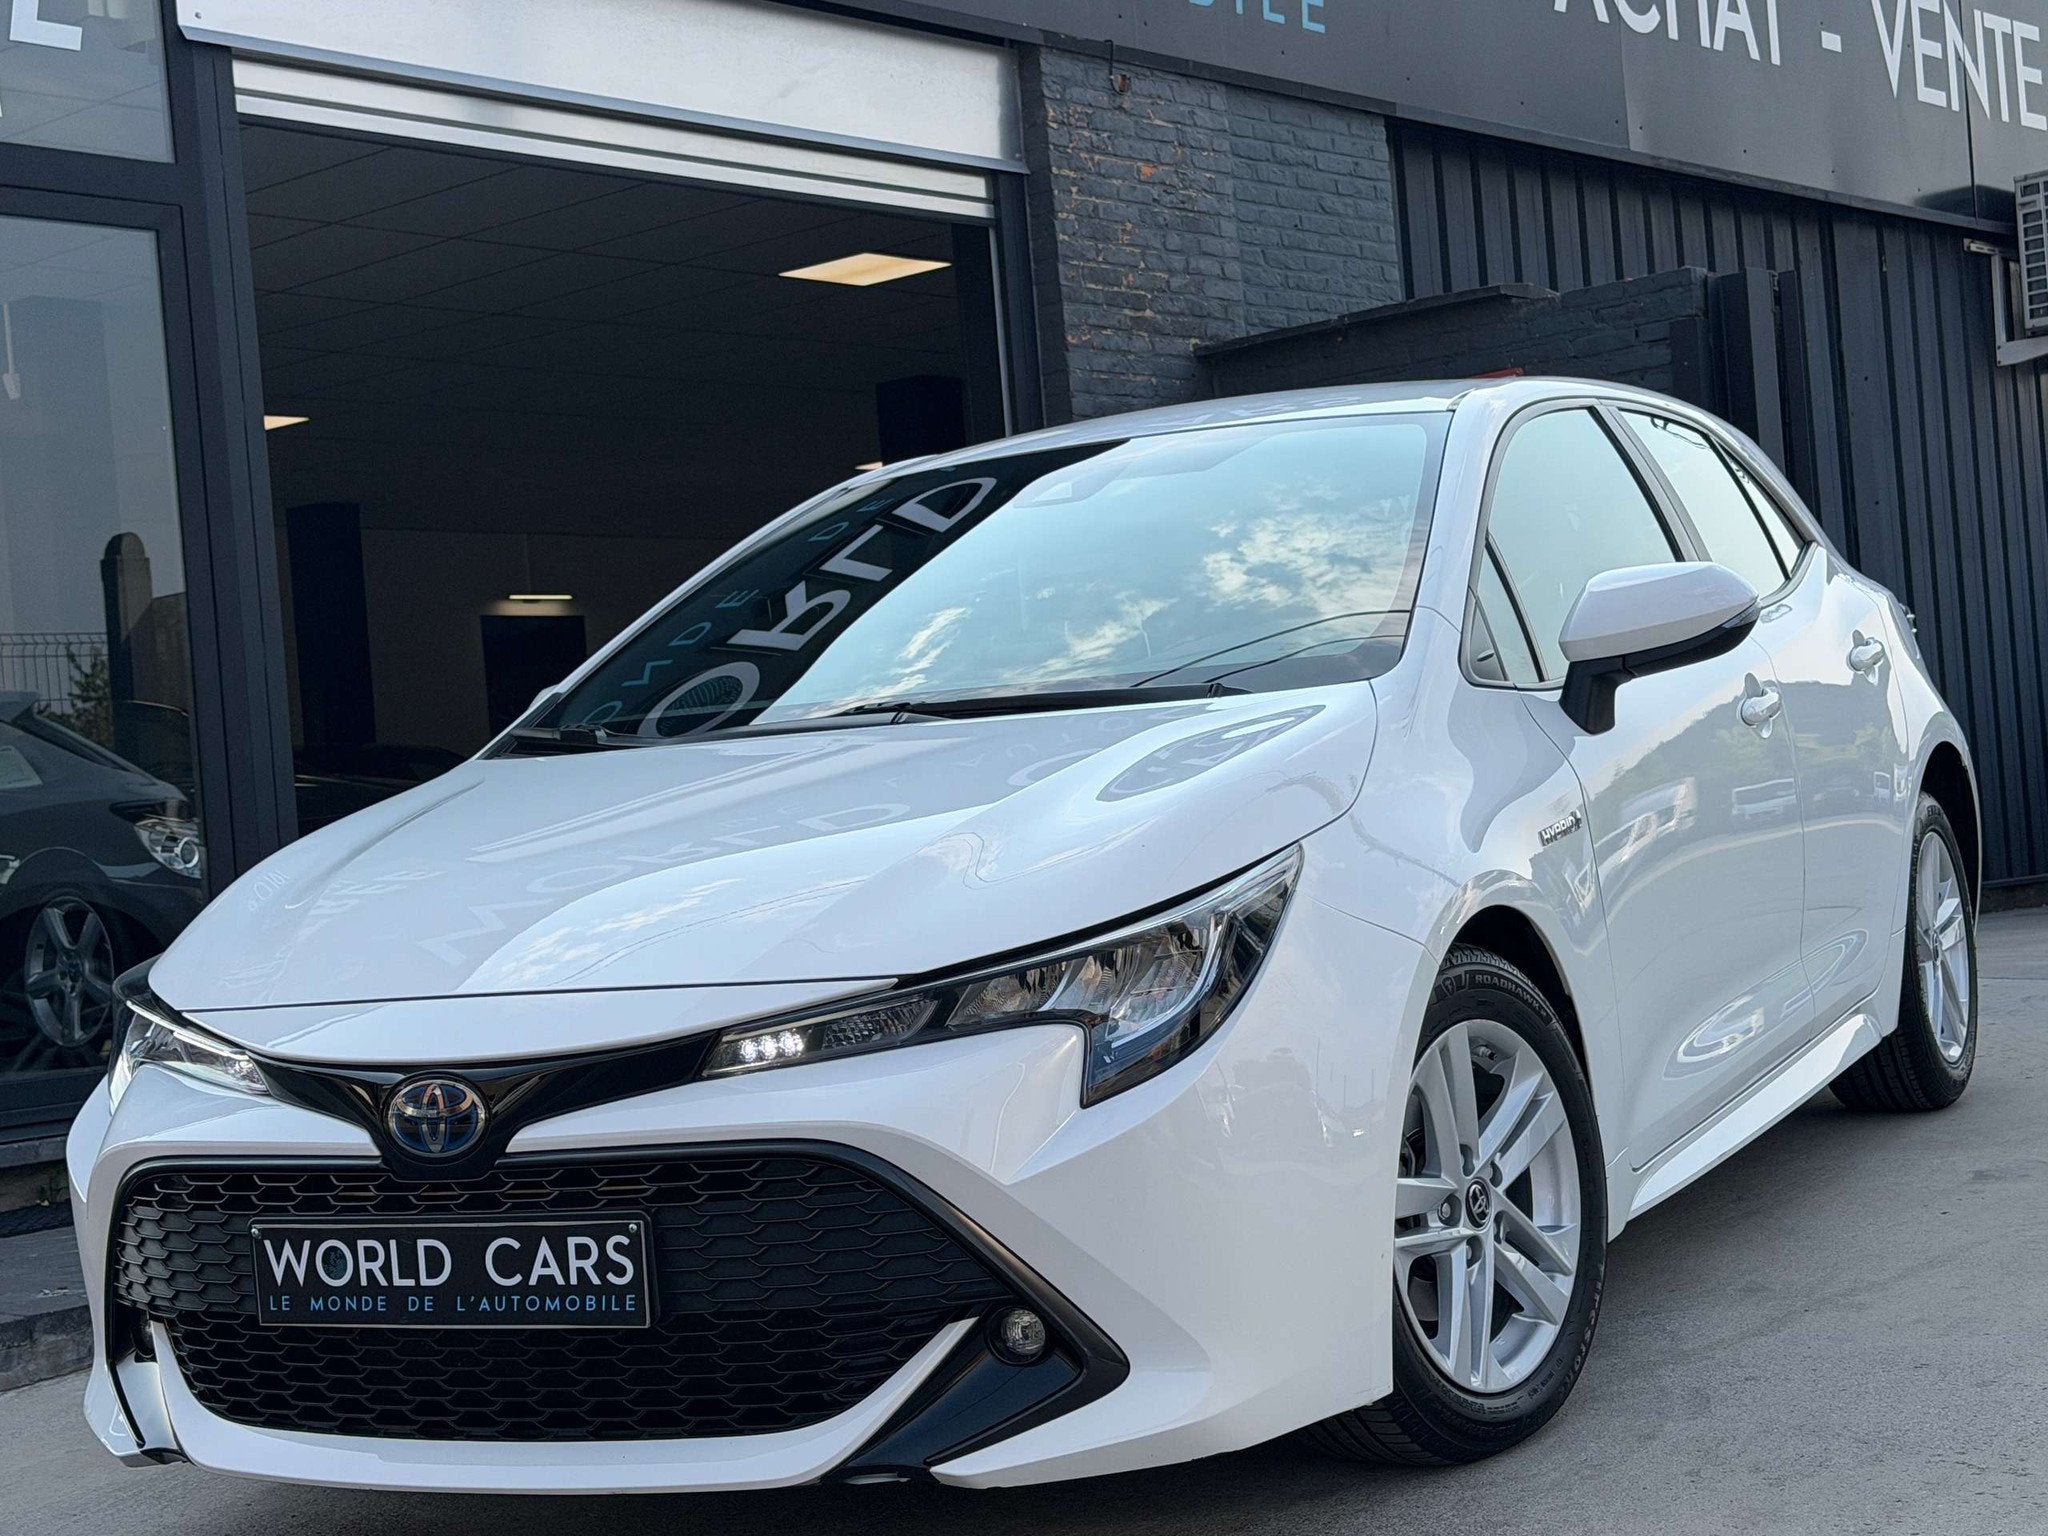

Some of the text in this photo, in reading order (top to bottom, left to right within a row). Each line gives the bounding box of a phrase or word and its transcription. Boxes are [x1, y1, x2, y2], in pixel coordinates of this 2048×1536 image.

[1871, 0, 2048, 131] VENTE
[263, 1234, 635, 1287] WORLD CARS
[269, 1294, 637, 1312] LE MONDE DE L'AUTOMOBILE
